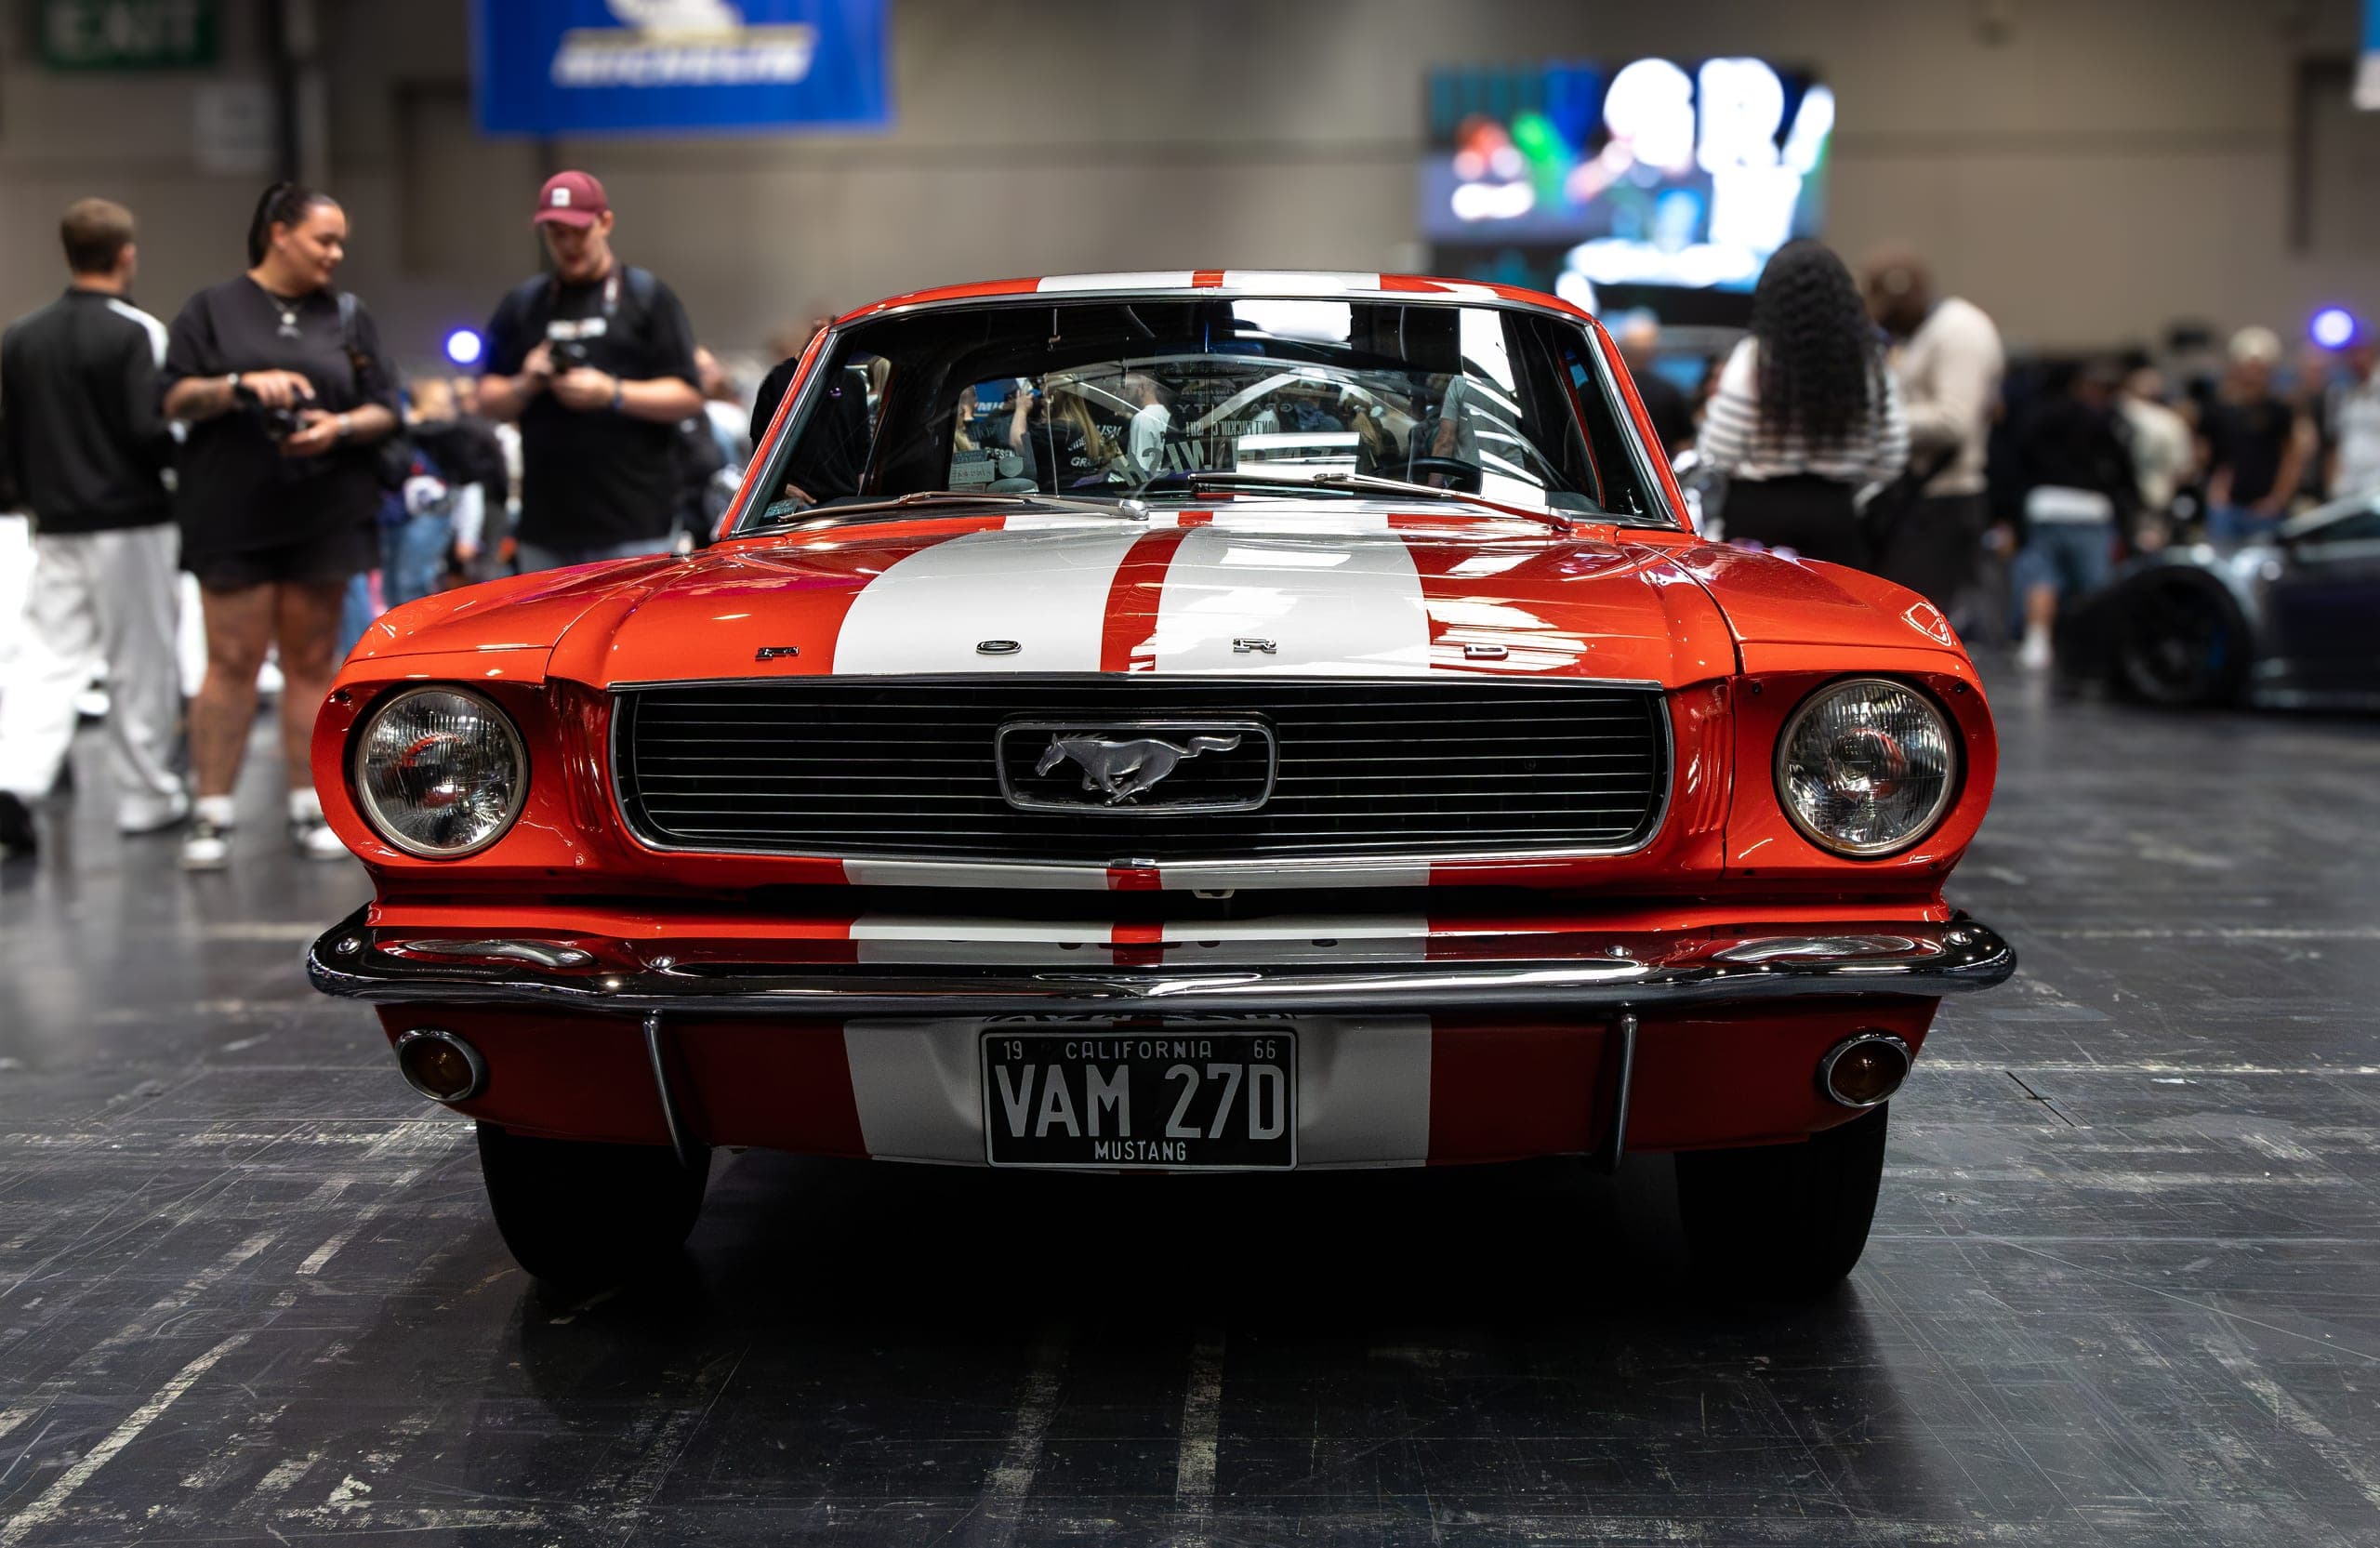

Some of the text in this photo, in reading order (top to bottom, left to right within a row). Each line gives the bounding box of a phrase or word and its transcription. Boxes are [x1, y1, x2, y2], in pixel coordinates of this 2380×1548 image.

[755, 638, 1509, 662] FORD
[1004, 1039, 1276, 1060] 19 CALIFORNIA 66
[995, 1063, 1285, 1140] VAM 27D
[1094, 1140, 1187, 1161] MUSTANG
